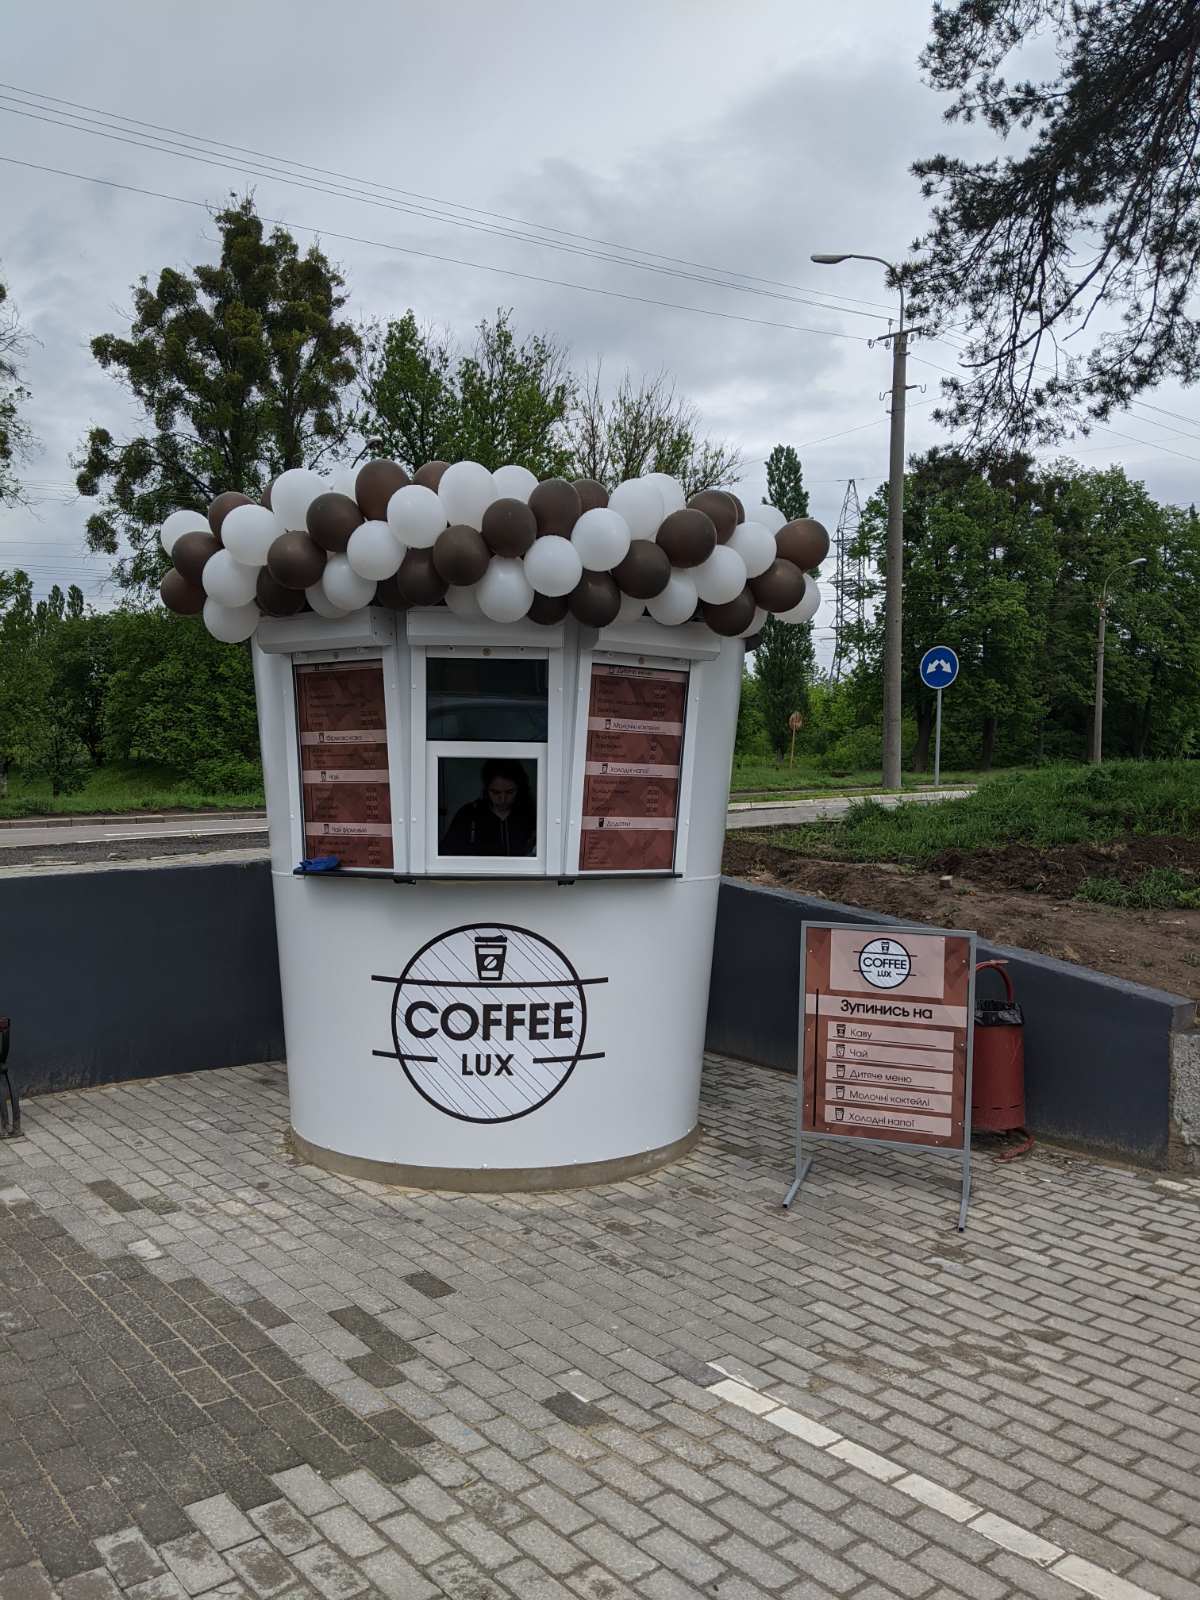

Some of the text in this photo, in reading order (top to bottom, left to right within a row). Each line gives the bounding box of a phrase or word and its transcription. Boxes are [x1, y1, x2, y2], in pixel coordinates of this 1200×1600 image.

[863, 957, 907, 970] COFFEE
[877, 970, 892, 978] LUX
[840, 999, 933, 1019] Зупинись на
[404, 1000, 574, 1041] COFFEE
[850, 1028, 873, 1039] Каву
[849, 1048, 868, 1058] Чай
[461, 1053, 514, 1076] LUX
[849, 1069, 913, 1084] Дитяче меню
[849, 1090, 930, 1107] Молочні коктейлі
[848, 1111, 915, 1128] Холодні напої
